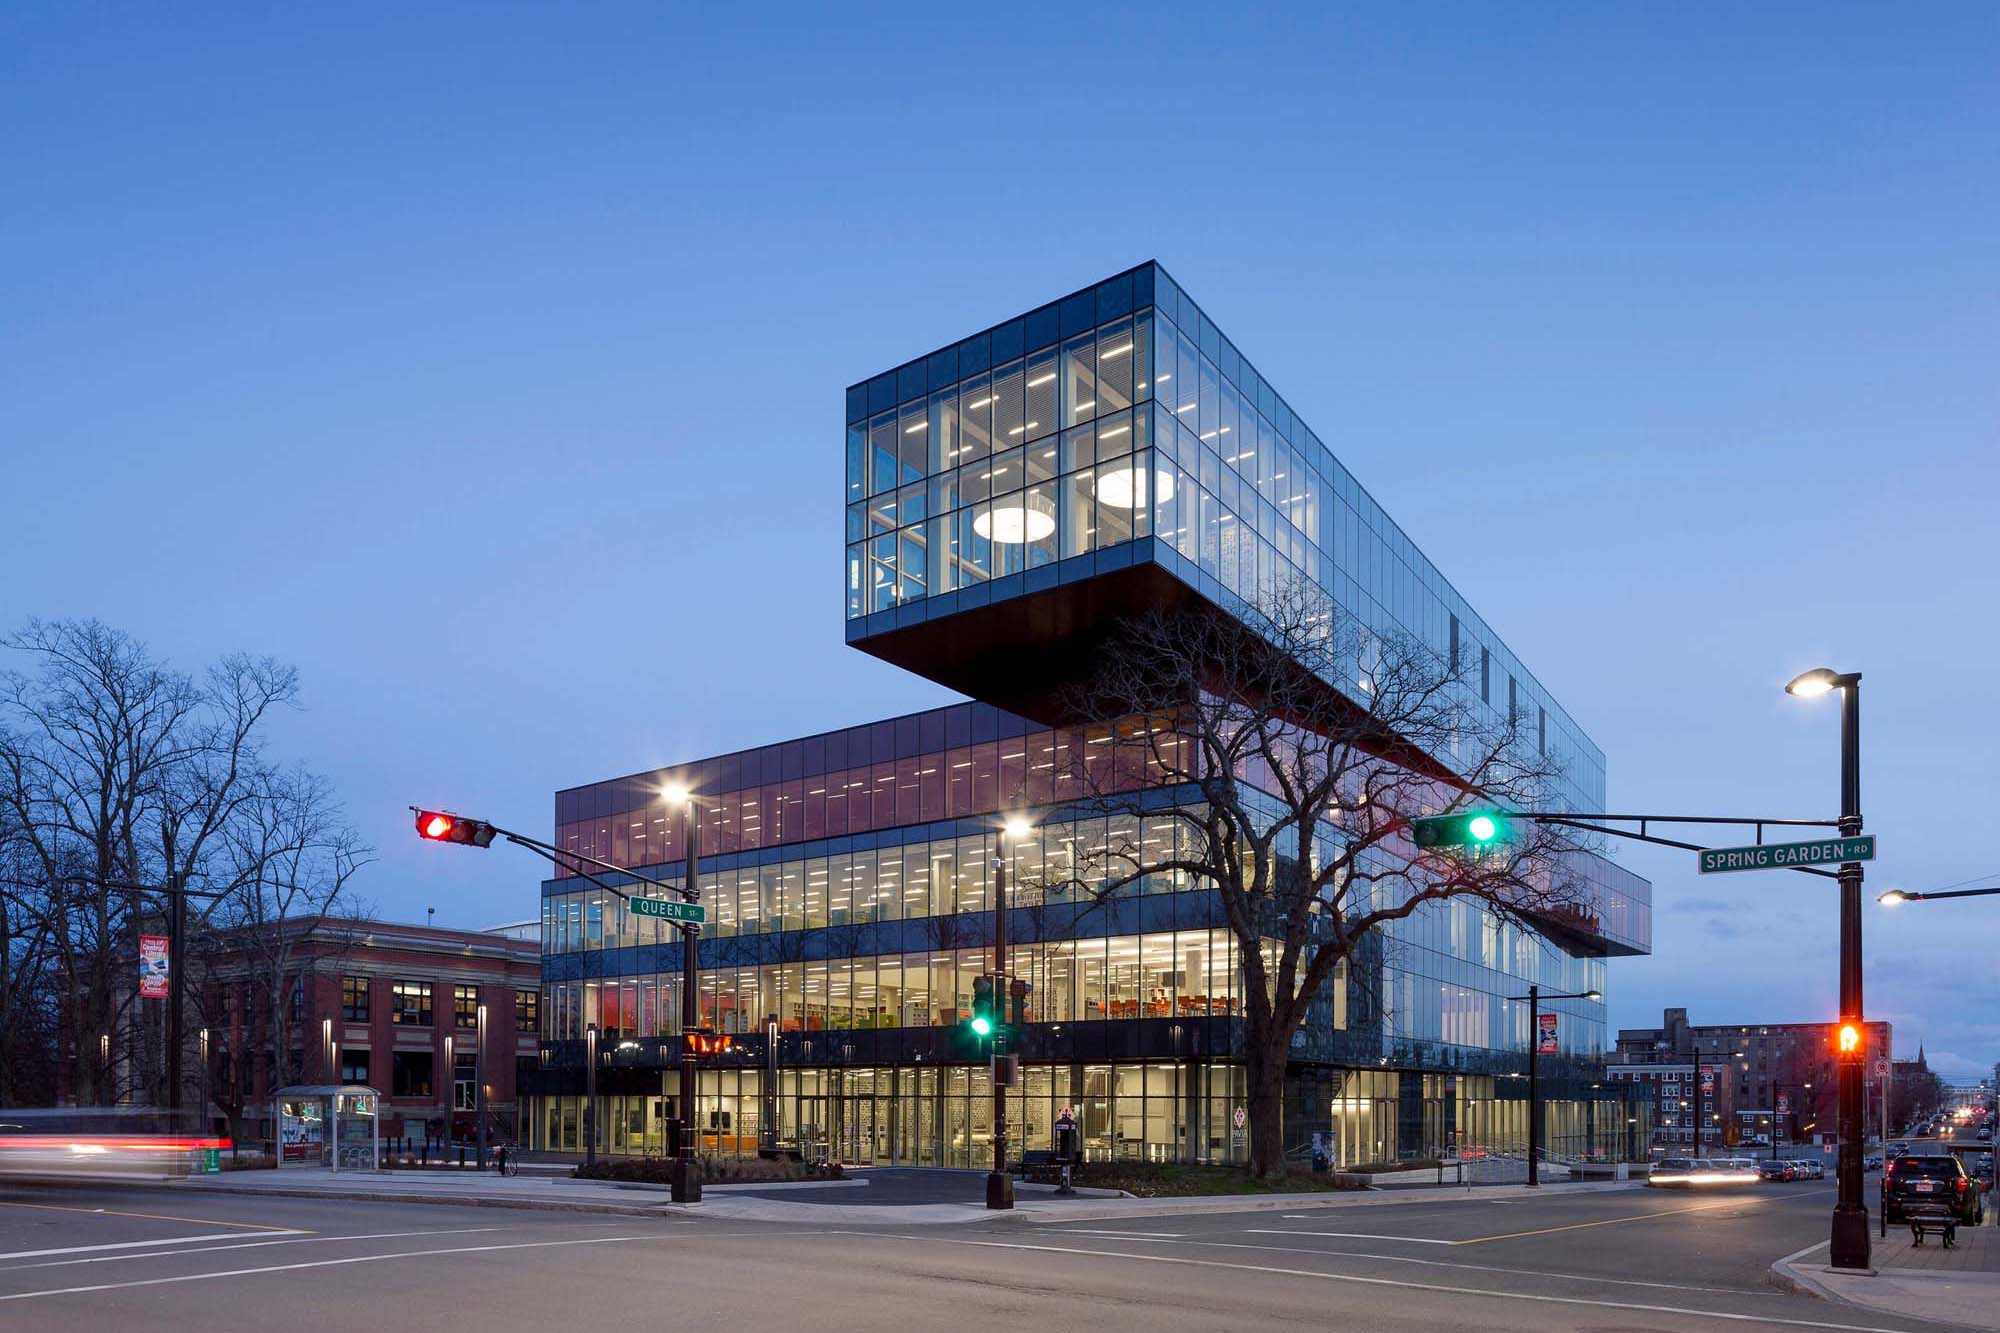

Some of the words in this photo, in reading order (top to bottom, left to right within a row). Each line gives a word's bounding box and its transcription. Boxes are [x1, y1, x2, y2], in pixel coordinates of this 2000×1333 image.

[1706, 850, 1768, 869] SPRING
[1774, 843, 1844, 863] GARDEN
[1854, 844, 1868, 854] RD
[641, 900, 682, 917] QUEEN
[142, 943, 165, 952] Central
